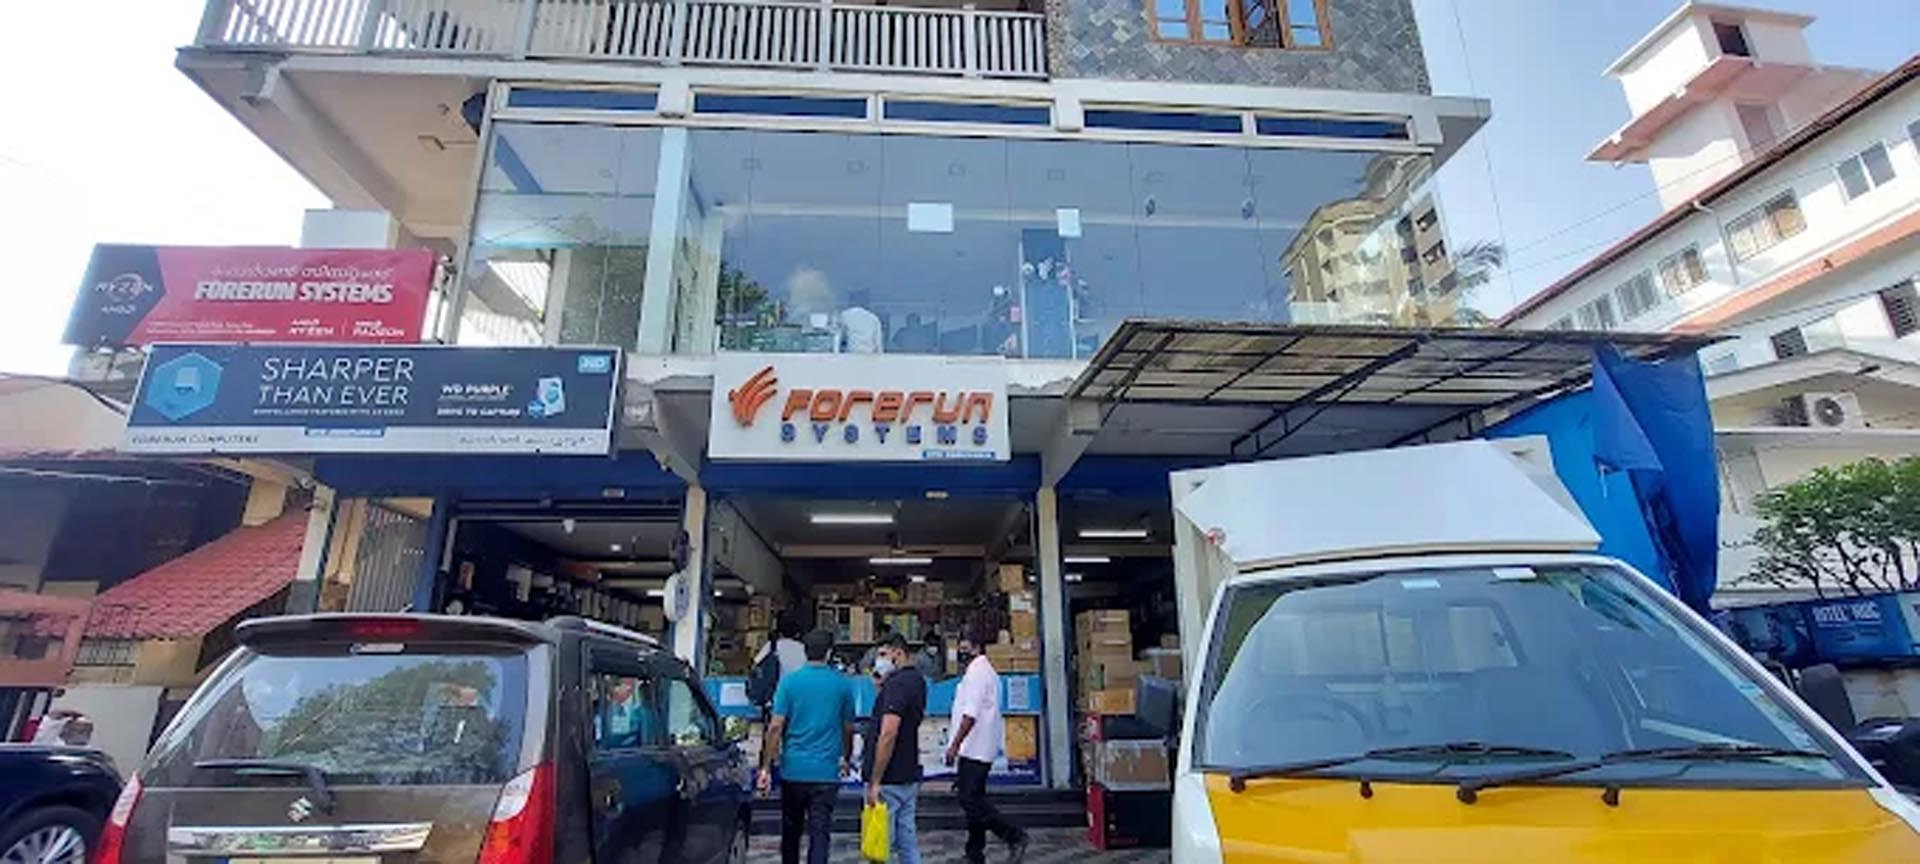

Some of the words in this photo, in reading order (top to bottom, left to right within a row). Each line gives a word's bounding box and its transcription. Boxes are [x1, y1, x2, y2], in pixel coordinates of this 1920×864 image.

[195, 280, 296, 301] FORERUN
[299, 282, 394, 304] SYSTEMS
[261, 356, 414, 382] SHARPER
[259, 384, 333, 405] THAN
[341, 385, 410, 406] EVER
[780, 423, 990, 446] SYSTEMS
